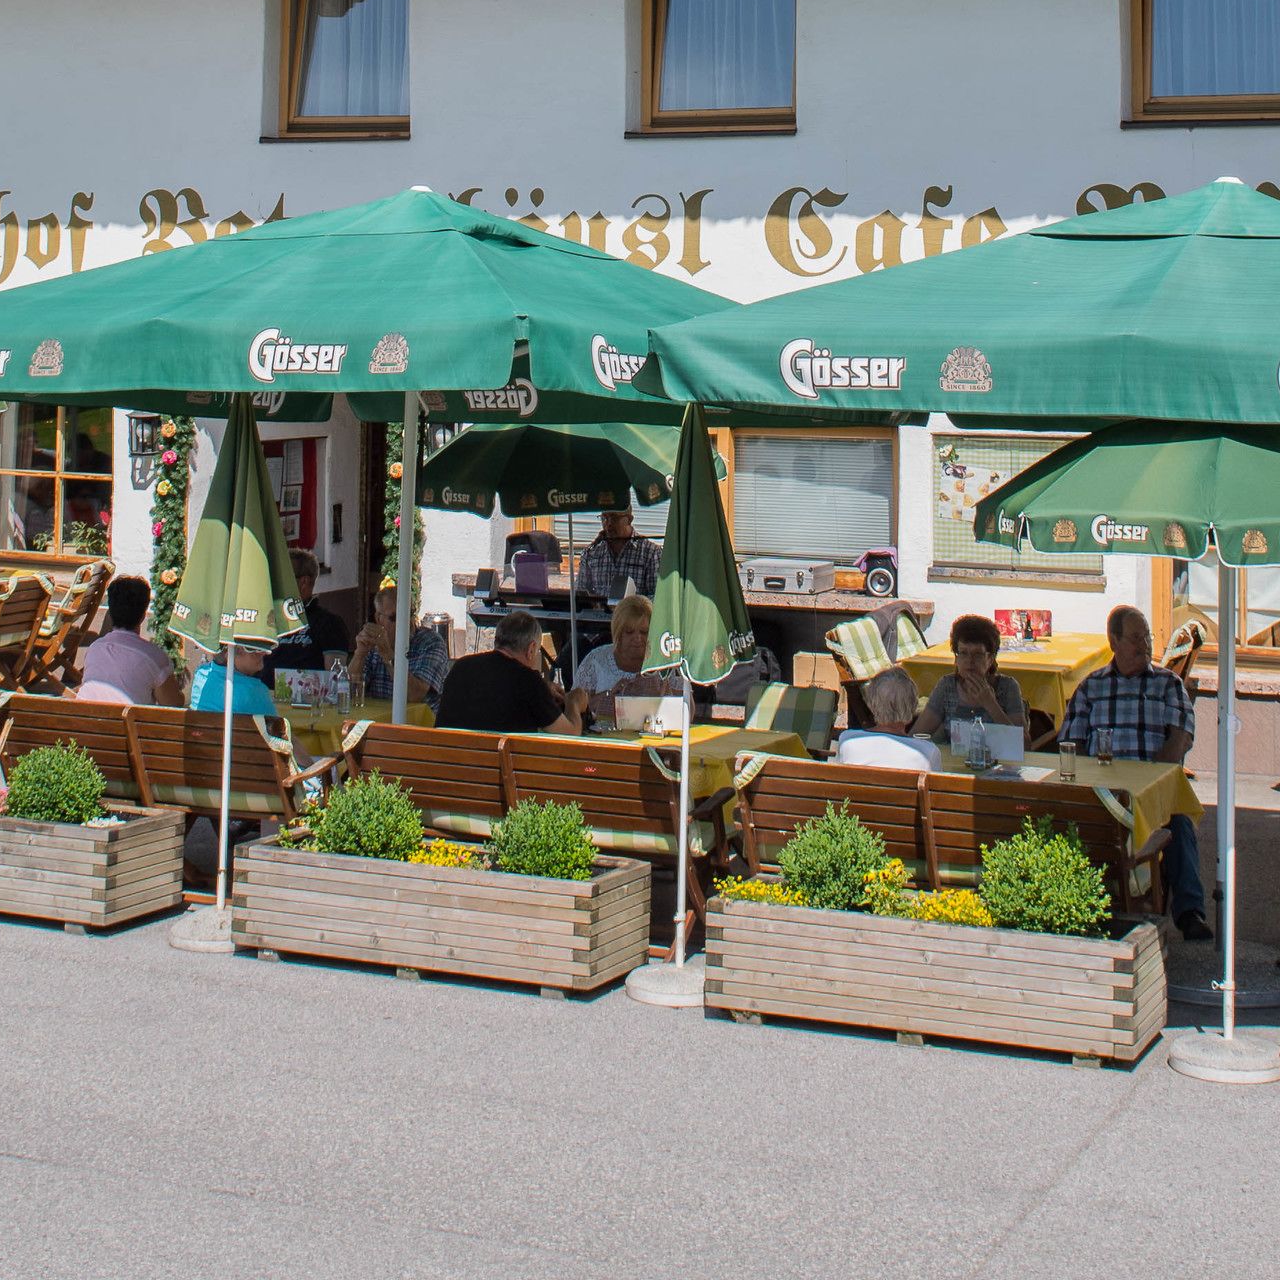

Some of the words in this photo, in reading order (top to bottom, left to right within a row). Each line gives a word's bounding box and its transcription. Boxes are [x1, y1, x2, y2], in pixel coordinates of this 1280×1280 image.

[249, 327, 348, 383] Gösser
[779, 338, 907, 399] Gösser
[441, 486, 470, 505] Gösser
[547, 488, 588, 508] Gösser
[1091, 514, 1149, 545] Gösser
